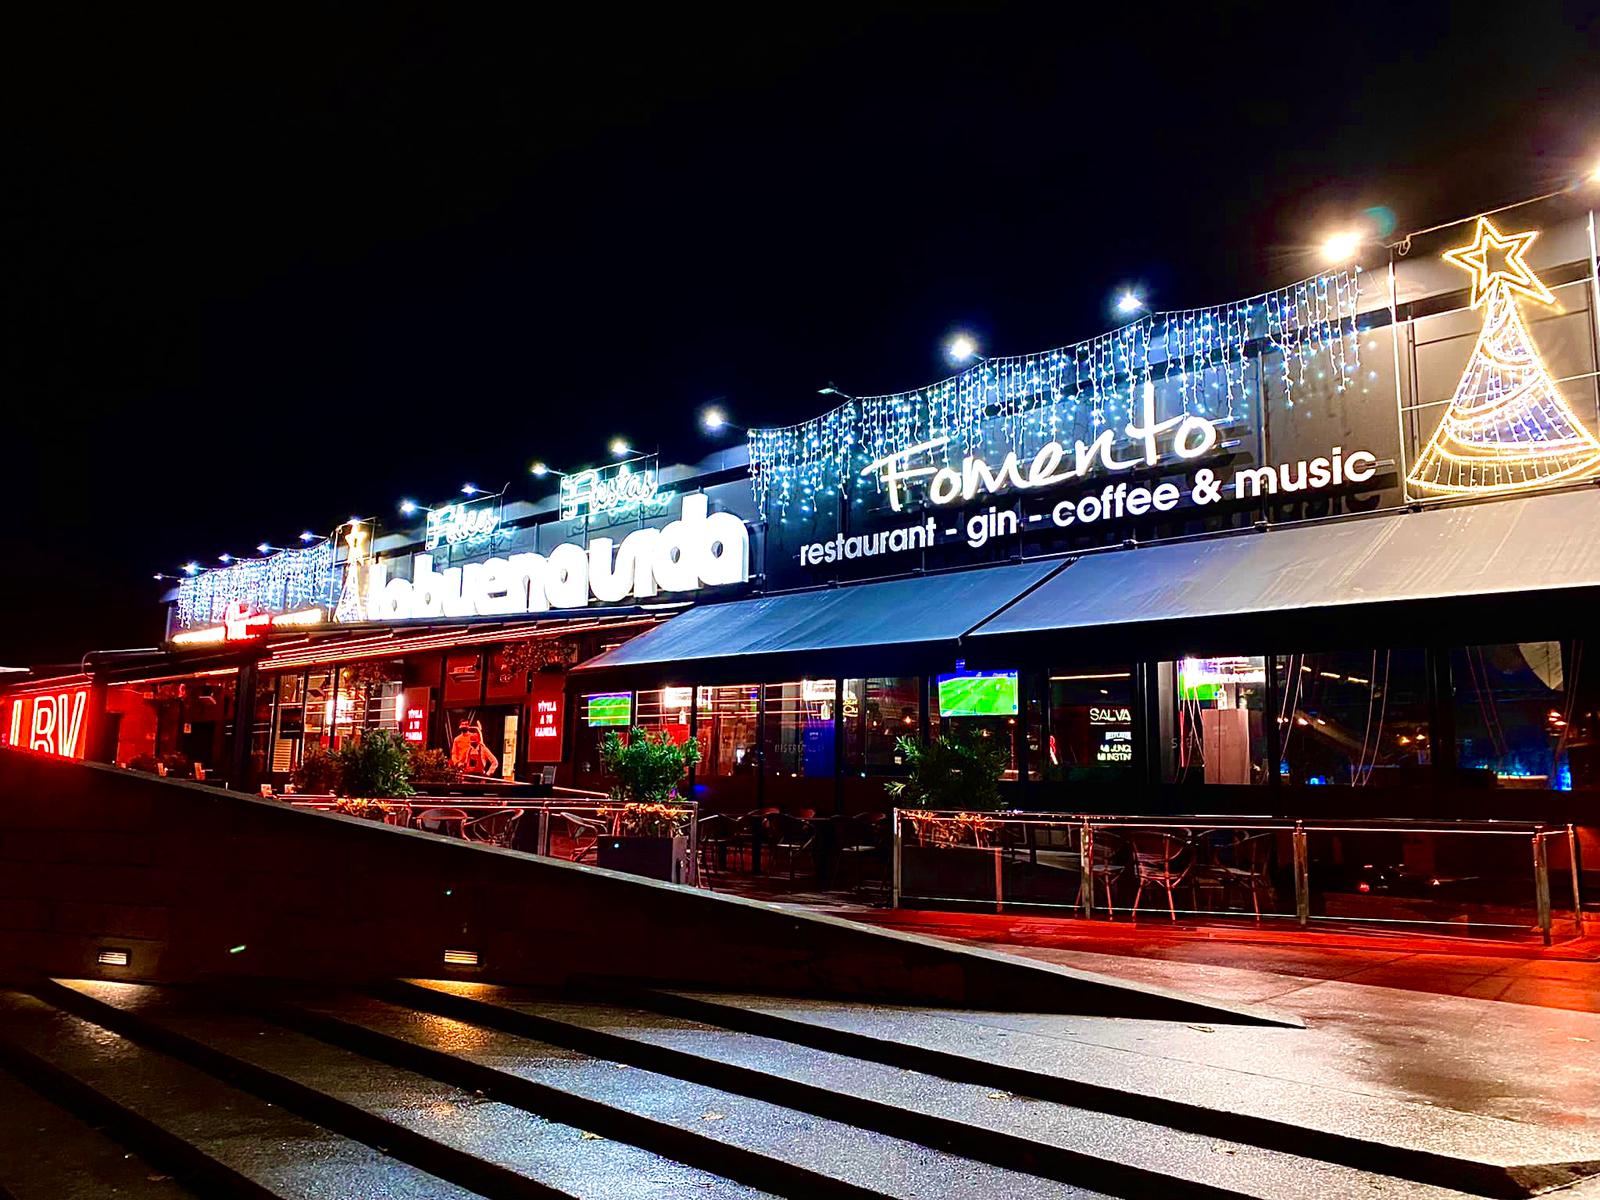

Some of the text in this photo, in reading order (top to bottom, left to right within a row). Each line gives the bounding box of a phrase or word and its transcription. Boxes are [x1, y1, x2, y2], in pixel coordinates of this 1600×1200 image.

[800, 517, 936, 566] restaurant
[967, 506, 1017, 548] gin
[1052, 482, 1180, 527] coffee
[1192, 469, 1222, 505] &
[1235, 446, 1377, 499] music
[860, 380, 1217, 512] Fomento
